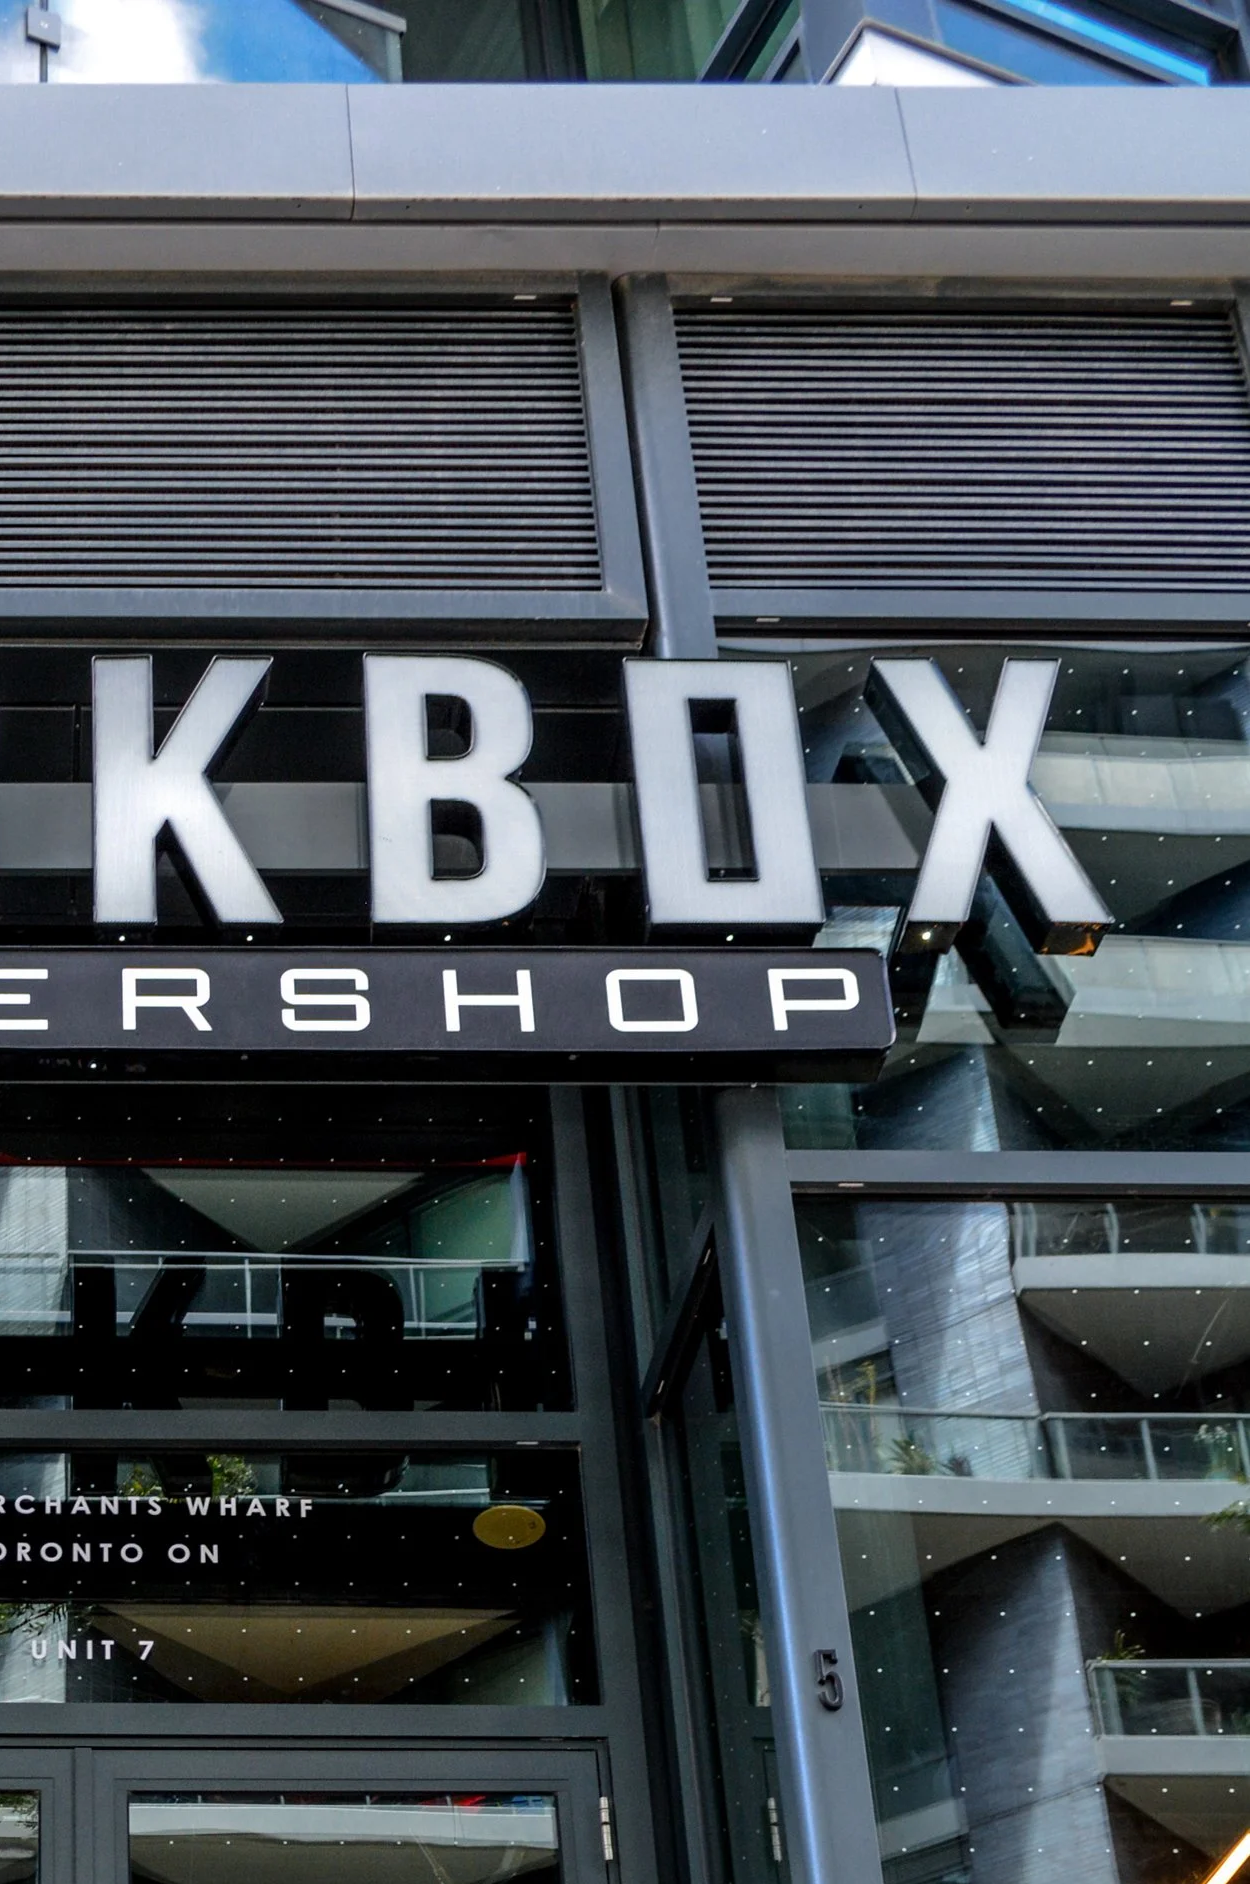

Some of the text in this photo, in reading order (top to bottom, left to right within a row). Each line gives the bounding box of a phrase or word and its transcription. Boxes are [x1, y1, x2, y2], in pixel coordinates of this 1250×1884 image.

[186, 1496, 316, 1518] WHARF
[168, 1543, 220, 1563] ON
[31, 1637, 154, 1660] UNIT 7
[812, 1648, 845, 1712] 5
